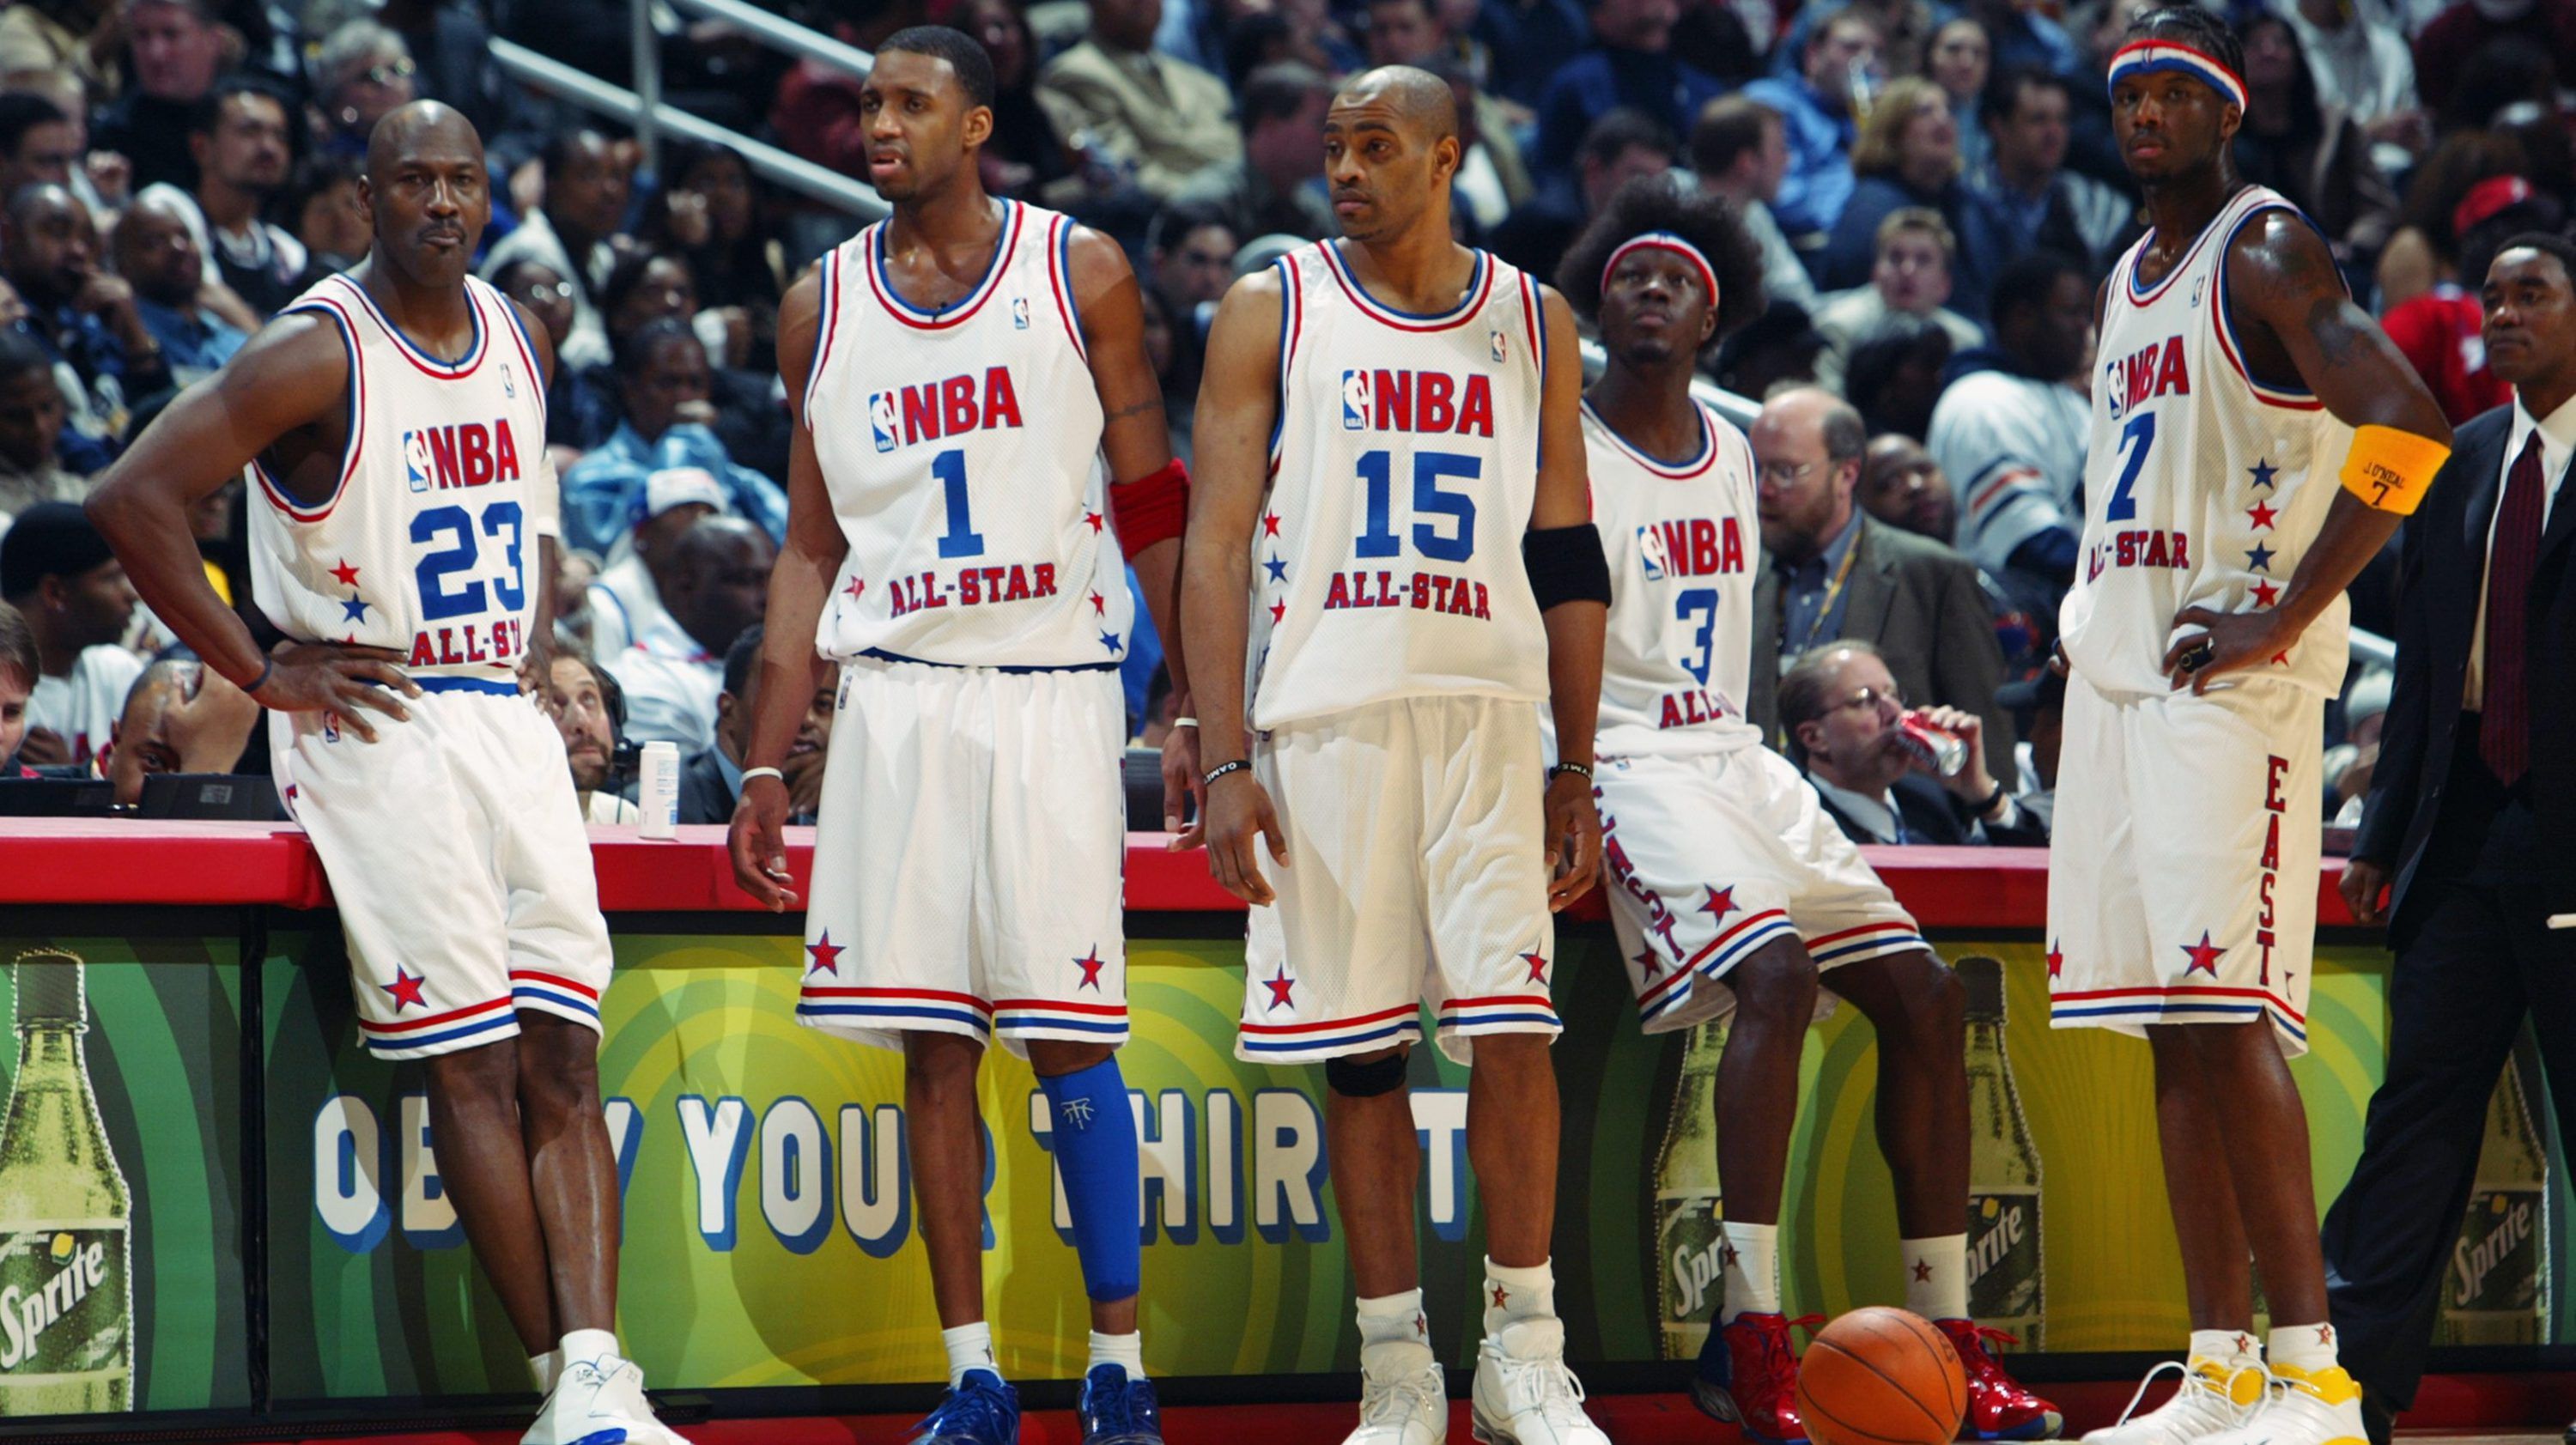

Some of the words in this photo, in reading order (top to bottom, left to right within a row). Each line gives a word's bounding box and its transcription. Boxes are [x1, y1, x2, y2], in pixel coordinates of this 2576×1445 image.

[900, 365, 1024, 446] NBA
[1373, 368, 1494, 439] NBA
[2126, 334, 2190, 416] NBA
[427, 418, 519, 490] NBA
[2105, 411, 2156, 523] 7
[2372, 480, 2391, 507] 7
[932, 449, 985, 559] 1
[1355, 450, 1482, 563] 15
[1662, 517, 1745, 577] NBA
[409, 501, 526, 622] 23
[889, 562, 1058, 619] ALL-STAR
[1323, 571, 1492, 622] ALL-STAR
[1675, 588, 1720, 687] 3
[2256, 753, 2289, 987] EAST
[677, 1094, 994, 1259] YOU
[2454, 1202, 2530, 1307] Sprite
[0, 1242, 108, 1369] Sprite
